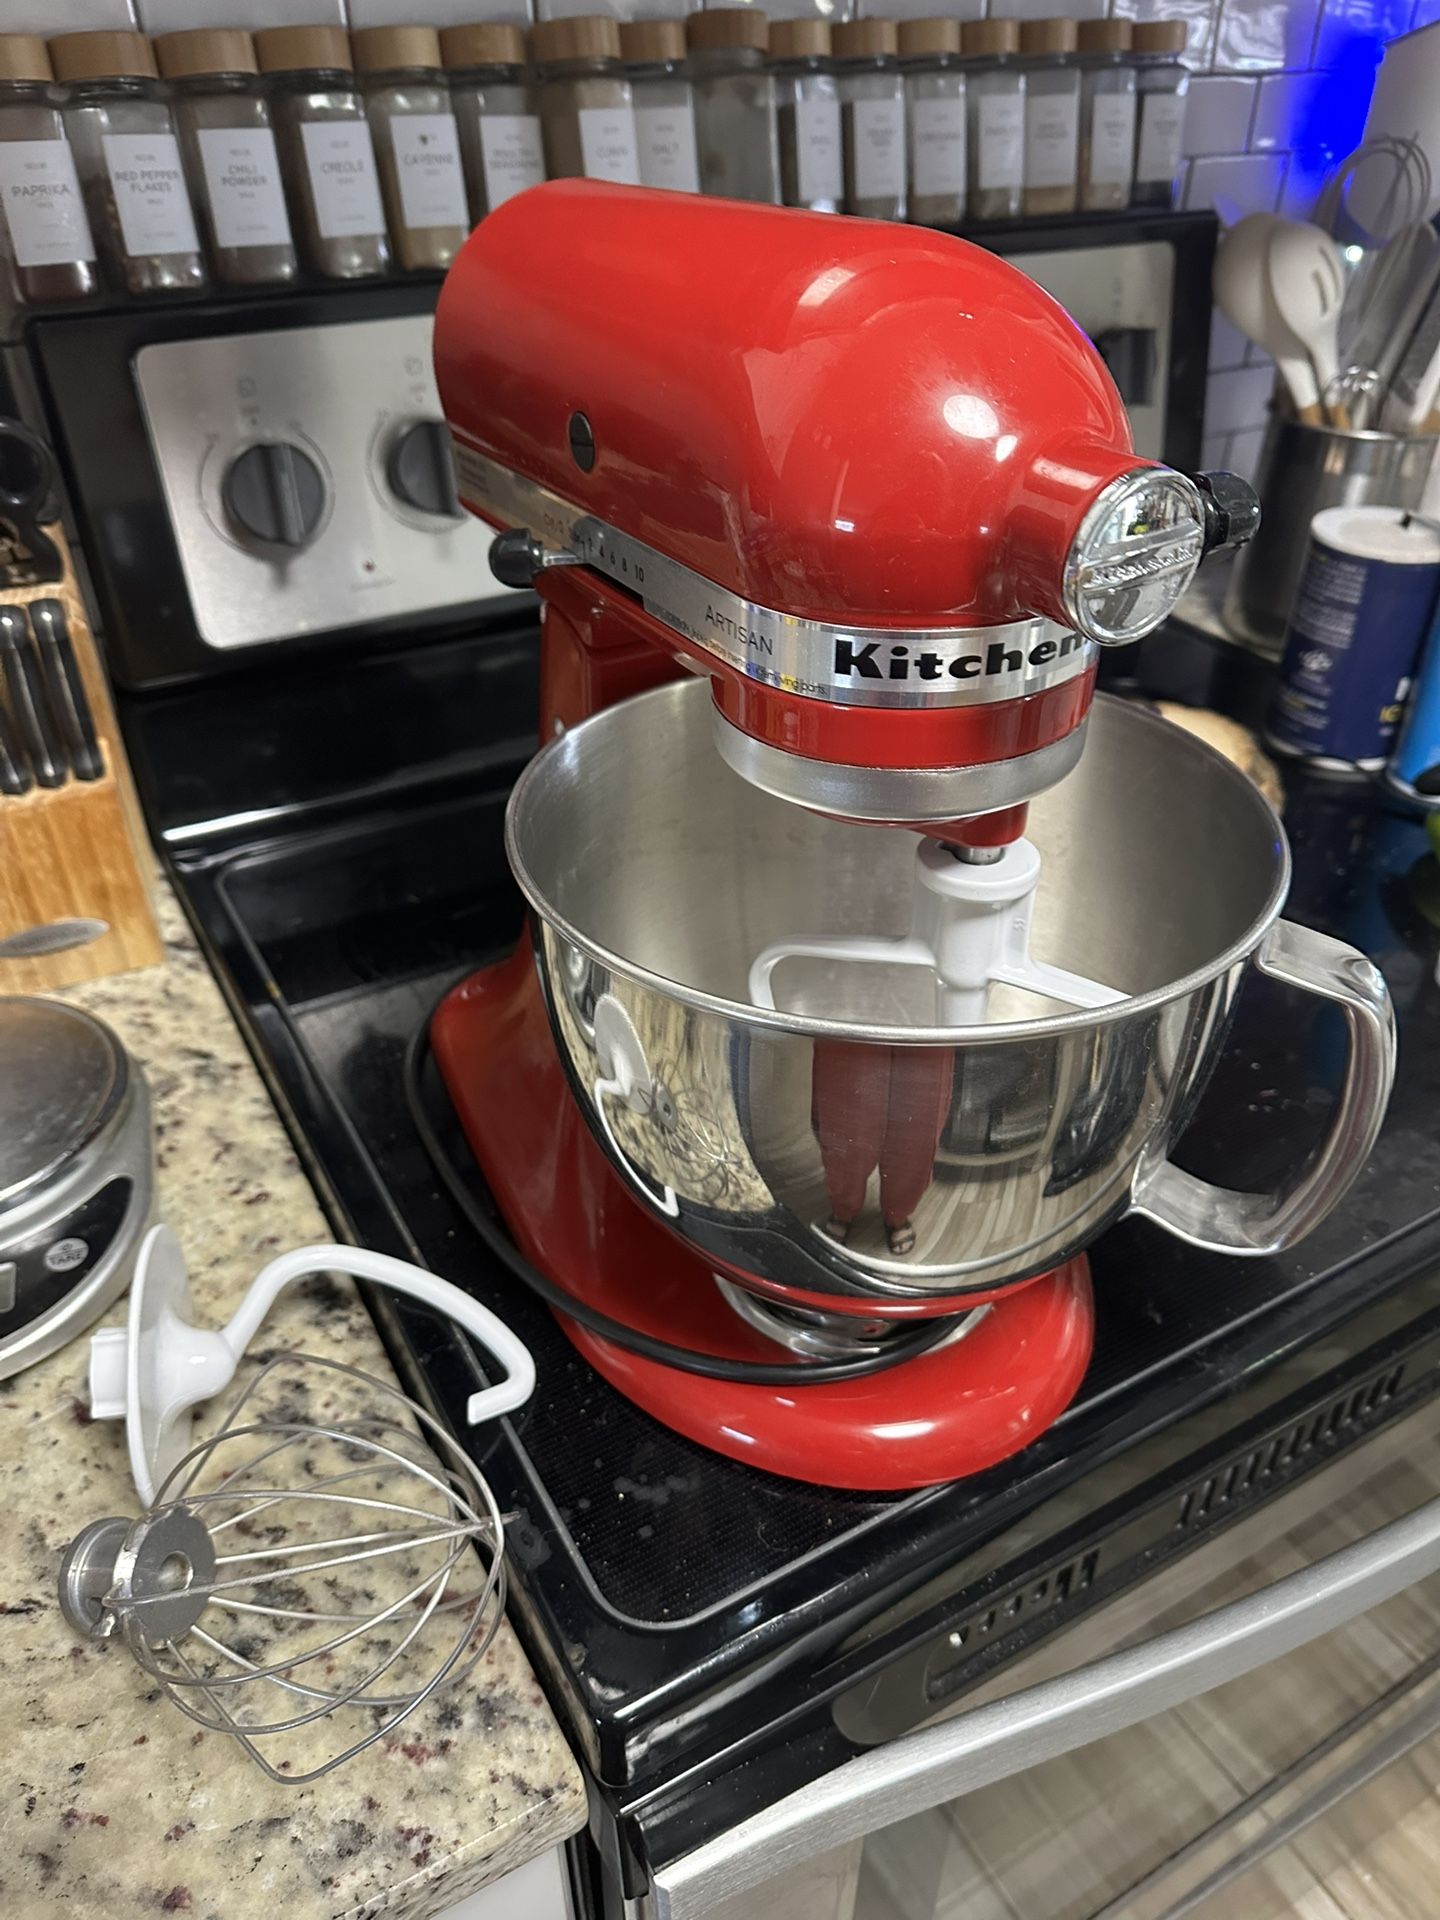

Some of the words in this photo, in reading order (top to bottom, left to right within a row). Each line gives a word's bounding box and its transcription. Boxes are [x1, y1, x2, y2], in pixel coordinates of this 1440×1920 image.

[403, 153, 454, 166] CAYENNE
[227, 165, 258, 176] CHILI
[321, 159, 365, 174] CREOLE
[115, 171, 138, 181] RED
[140, 169, 182, 181] PEPPER
[221, 176, 268, 187] POWDER
[11, 184, 71, 197] PAPRIKA
[130, 181, 172, 193] FLAKES
[634, 564, 645, 583] 10
[704, 604, 774, 656] ARTISAN
